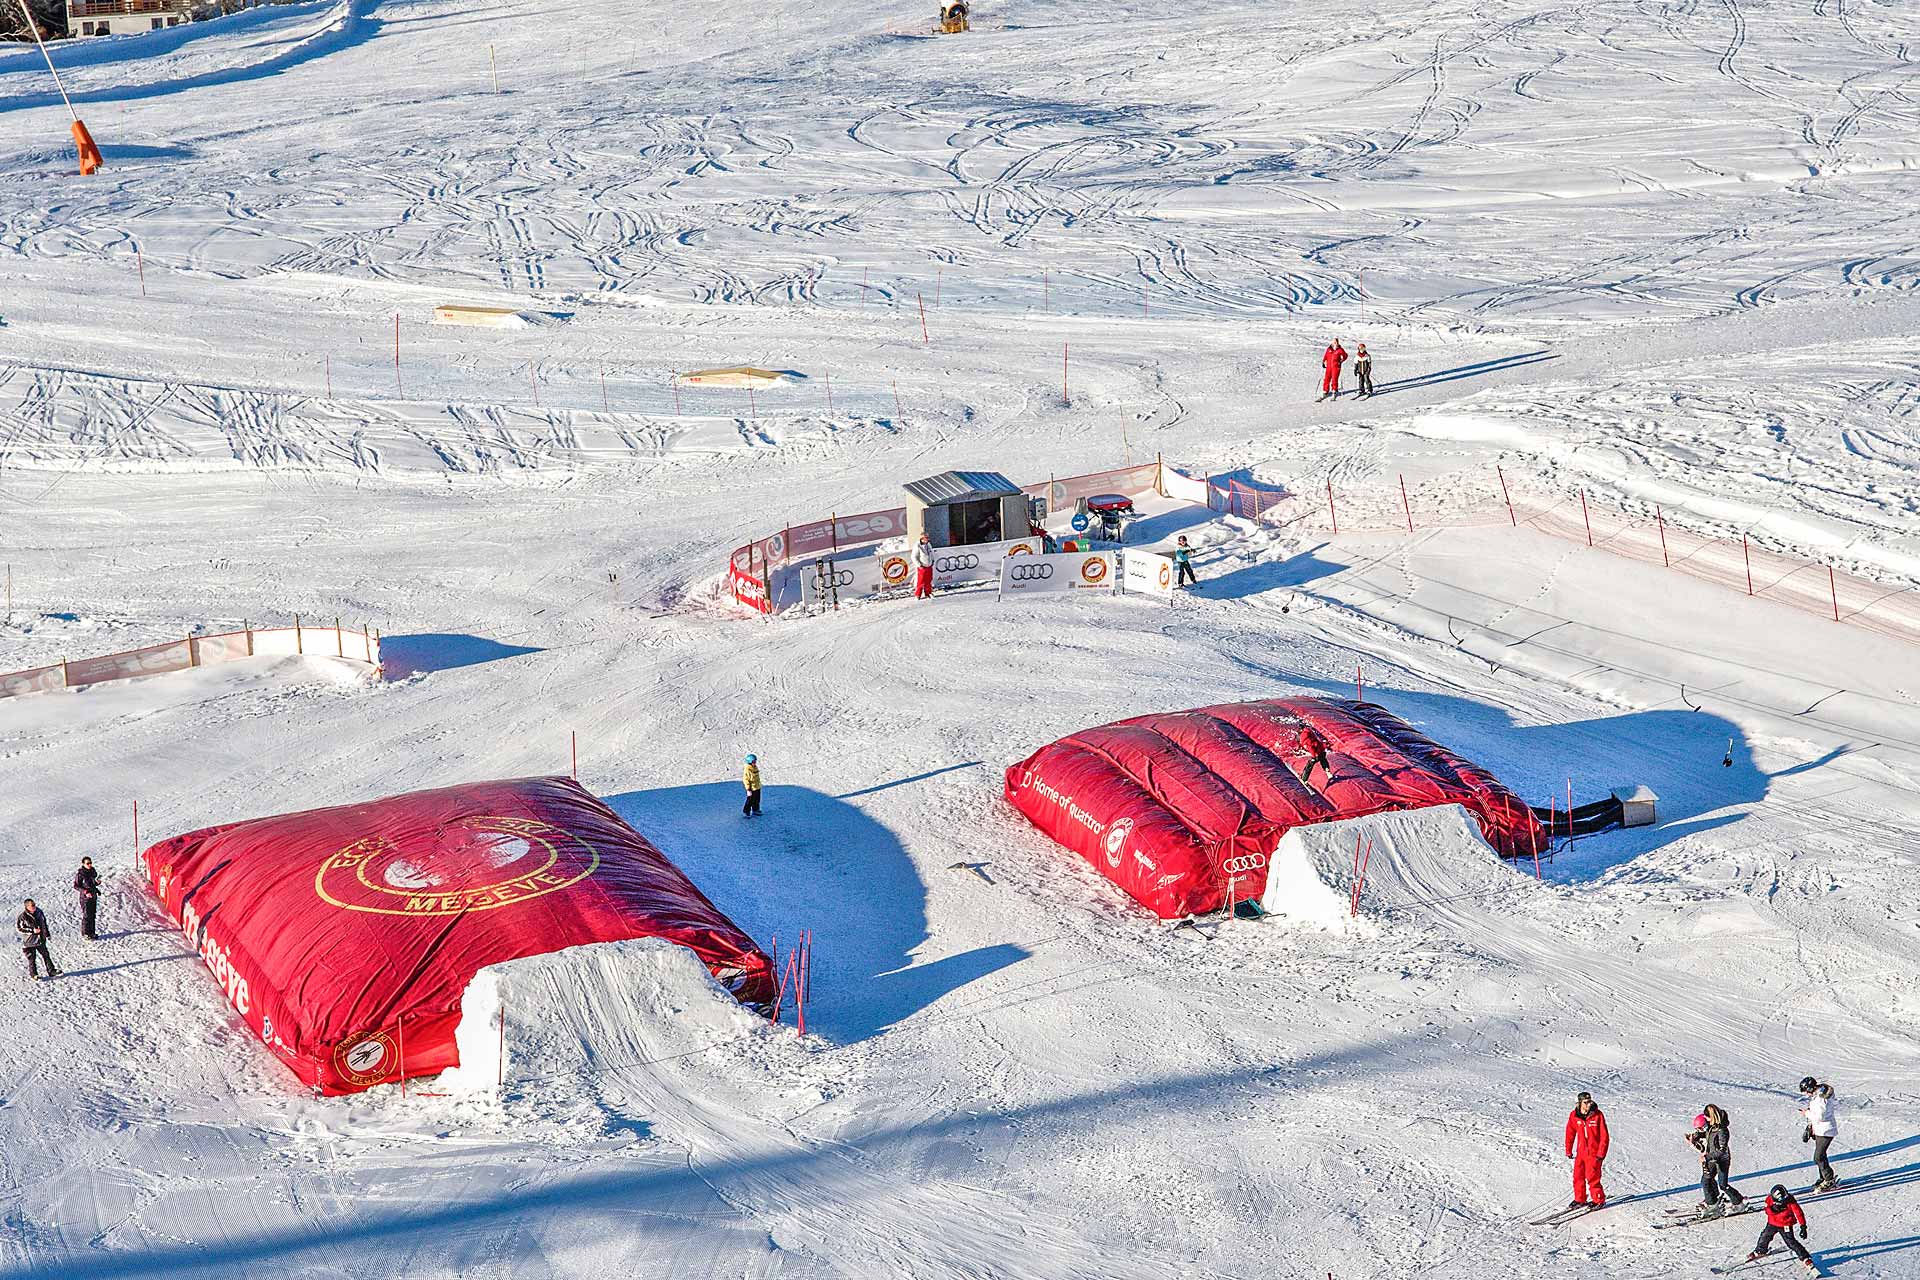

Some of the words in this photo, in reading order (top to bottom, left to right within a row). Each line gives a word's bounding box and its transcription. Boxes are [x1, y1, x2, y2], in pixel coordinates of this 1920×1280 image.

[1033, 775, 1060, 803] Home
[1059, 796, 1073, 811] of
[404, 872, 569, 912] MEGEVE
[351, 1069, 387, 1084] MEGEVE
